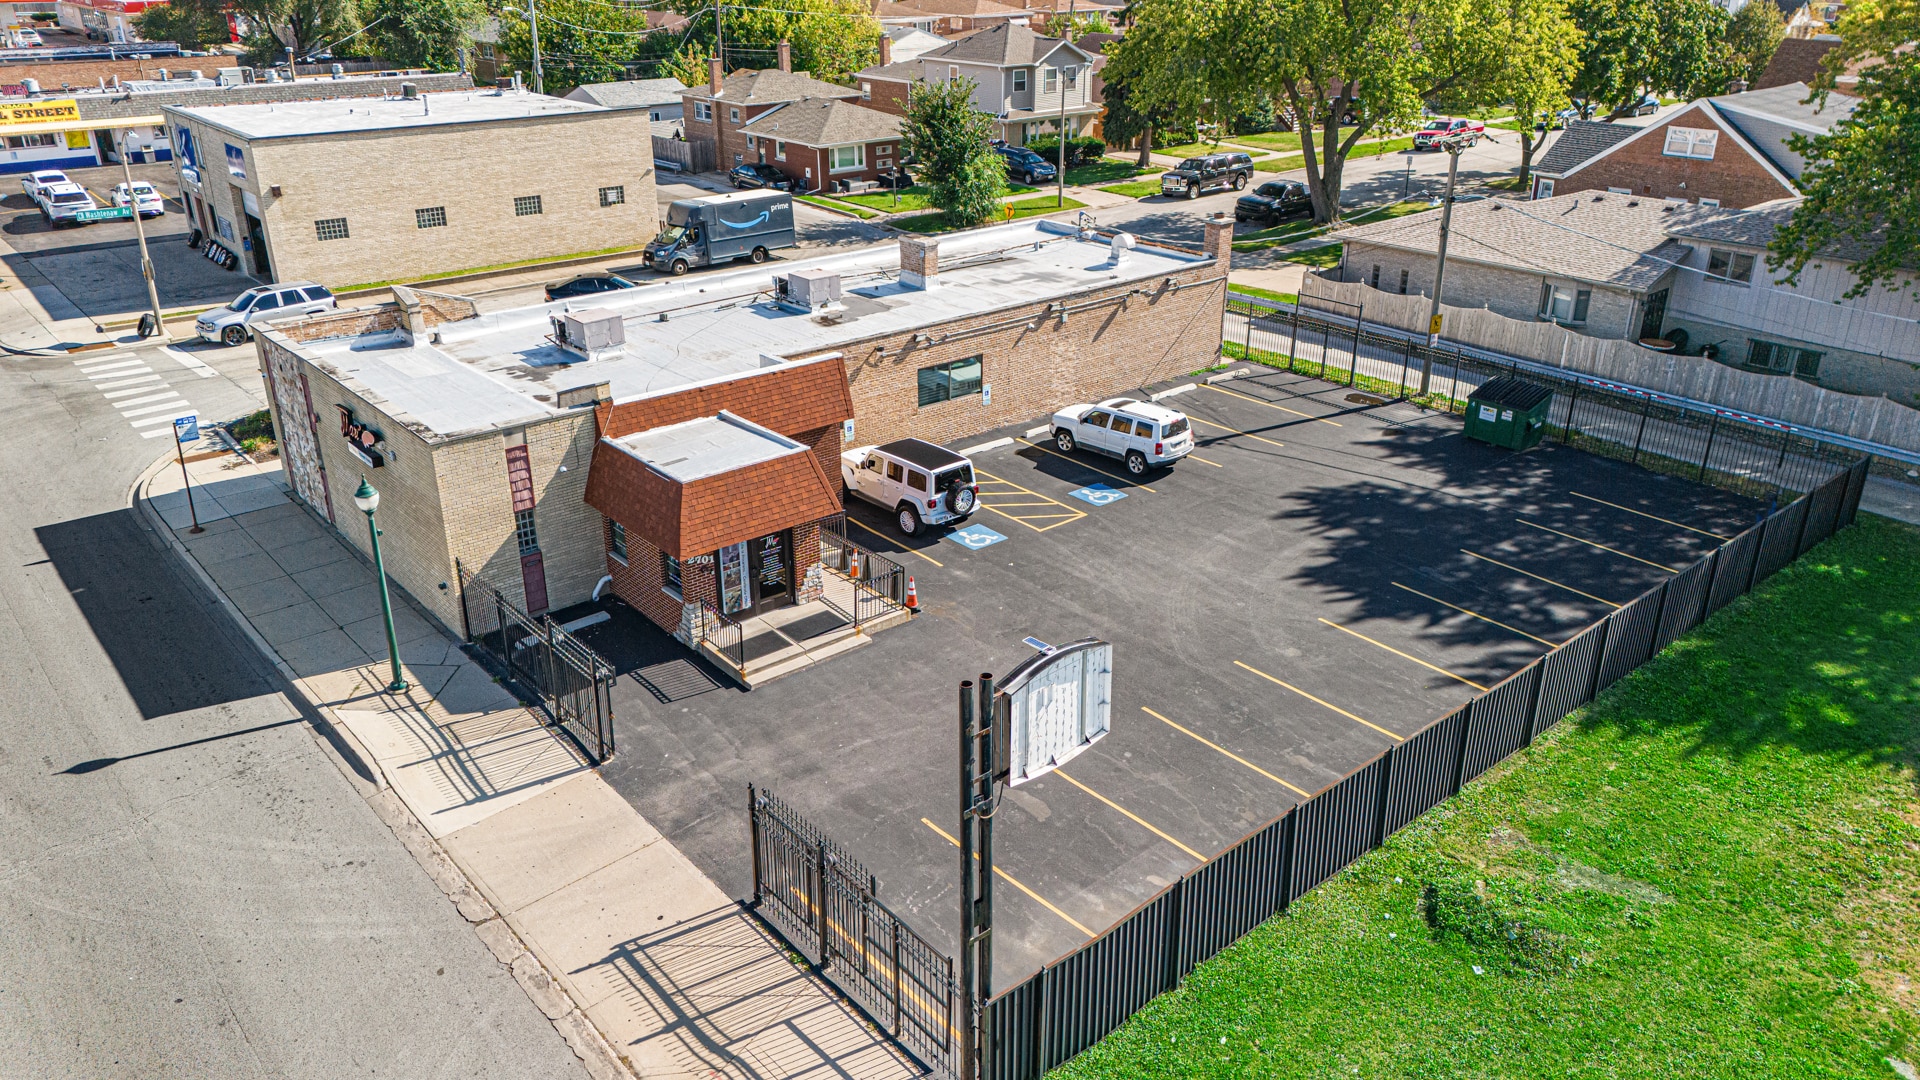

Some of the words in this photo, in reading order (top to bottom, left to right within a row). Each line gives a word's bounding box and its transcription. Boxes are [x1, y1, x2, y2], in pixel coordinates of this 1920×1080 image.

[2, 85, 29, 95] OPEN
[13, 106, 76, 119] STREET
[85, 209, 118, 219] Washtenaw
[122, 207, 130, 216] Av
[770, 202, 789, 213] prime
[687, 555, 715, 565] 2701
